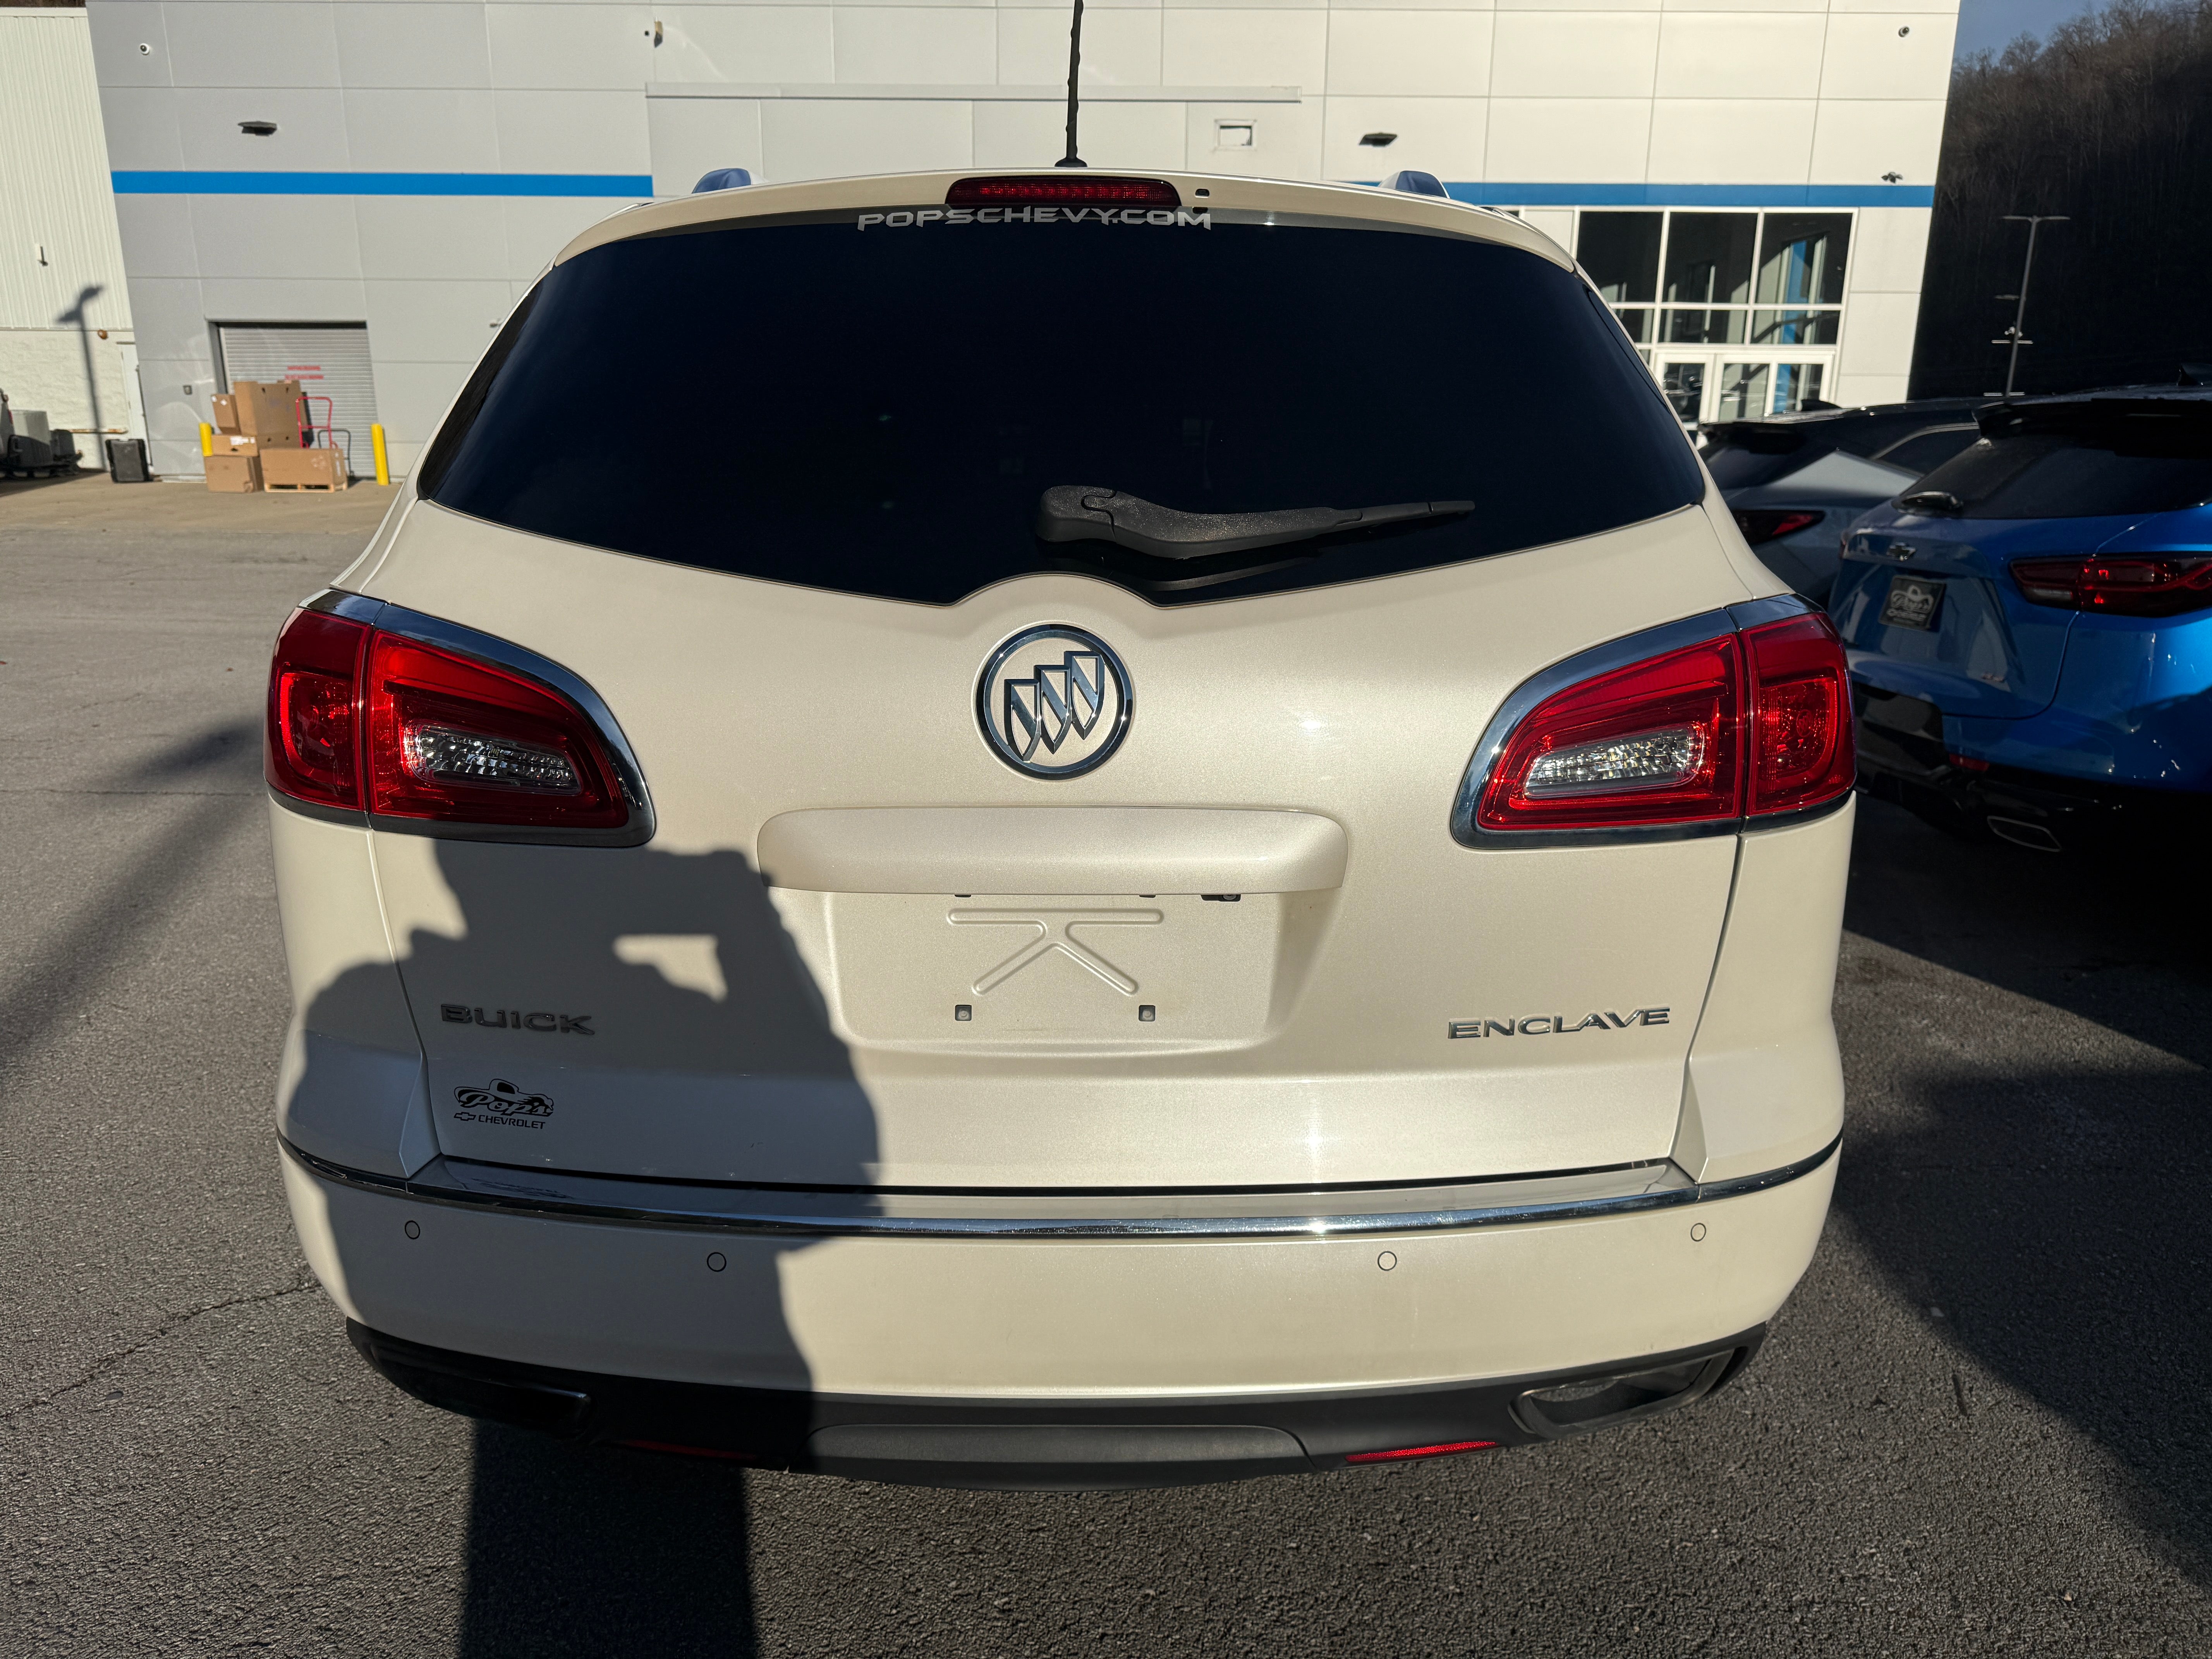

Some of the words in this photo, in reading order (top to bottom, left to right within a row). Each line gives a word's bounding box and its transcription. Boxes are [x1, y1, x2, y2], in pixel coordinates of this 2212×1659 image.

[857, 205, 1211, 231] POPSCHEVY.COM
[441, 1004, 595, 1035] BUICK
[1448, 1006, 1670, 1039] ENCLAVE
[478, 1115, 546, 1129] CHEVROLET
